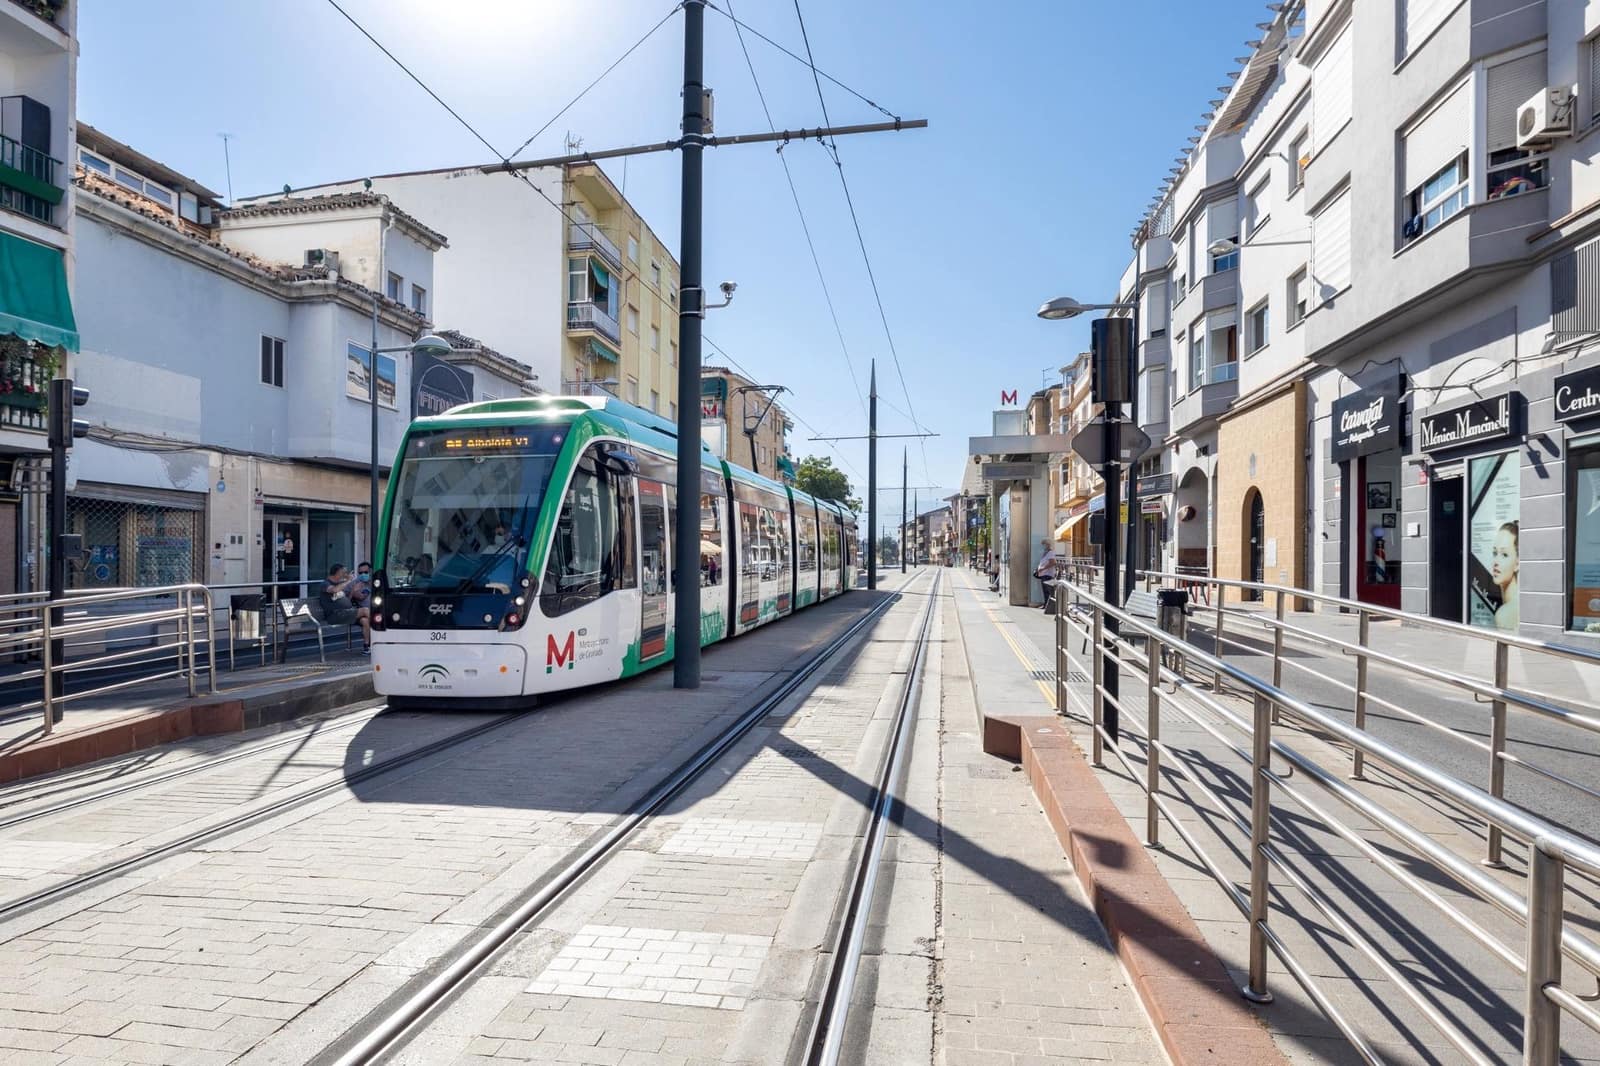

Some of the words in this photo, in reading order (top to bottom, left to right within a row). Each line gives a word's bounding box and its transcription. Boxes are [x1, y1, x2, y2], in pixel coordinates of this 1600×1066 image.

[1002, 389, 1017, 405] M
[1556, 386, 1600, 413] Centr
[1456, 397, 1510, 440] Mancinelli
[430, 631, 448, 641] 304
[546, 630, 575, 674] M
